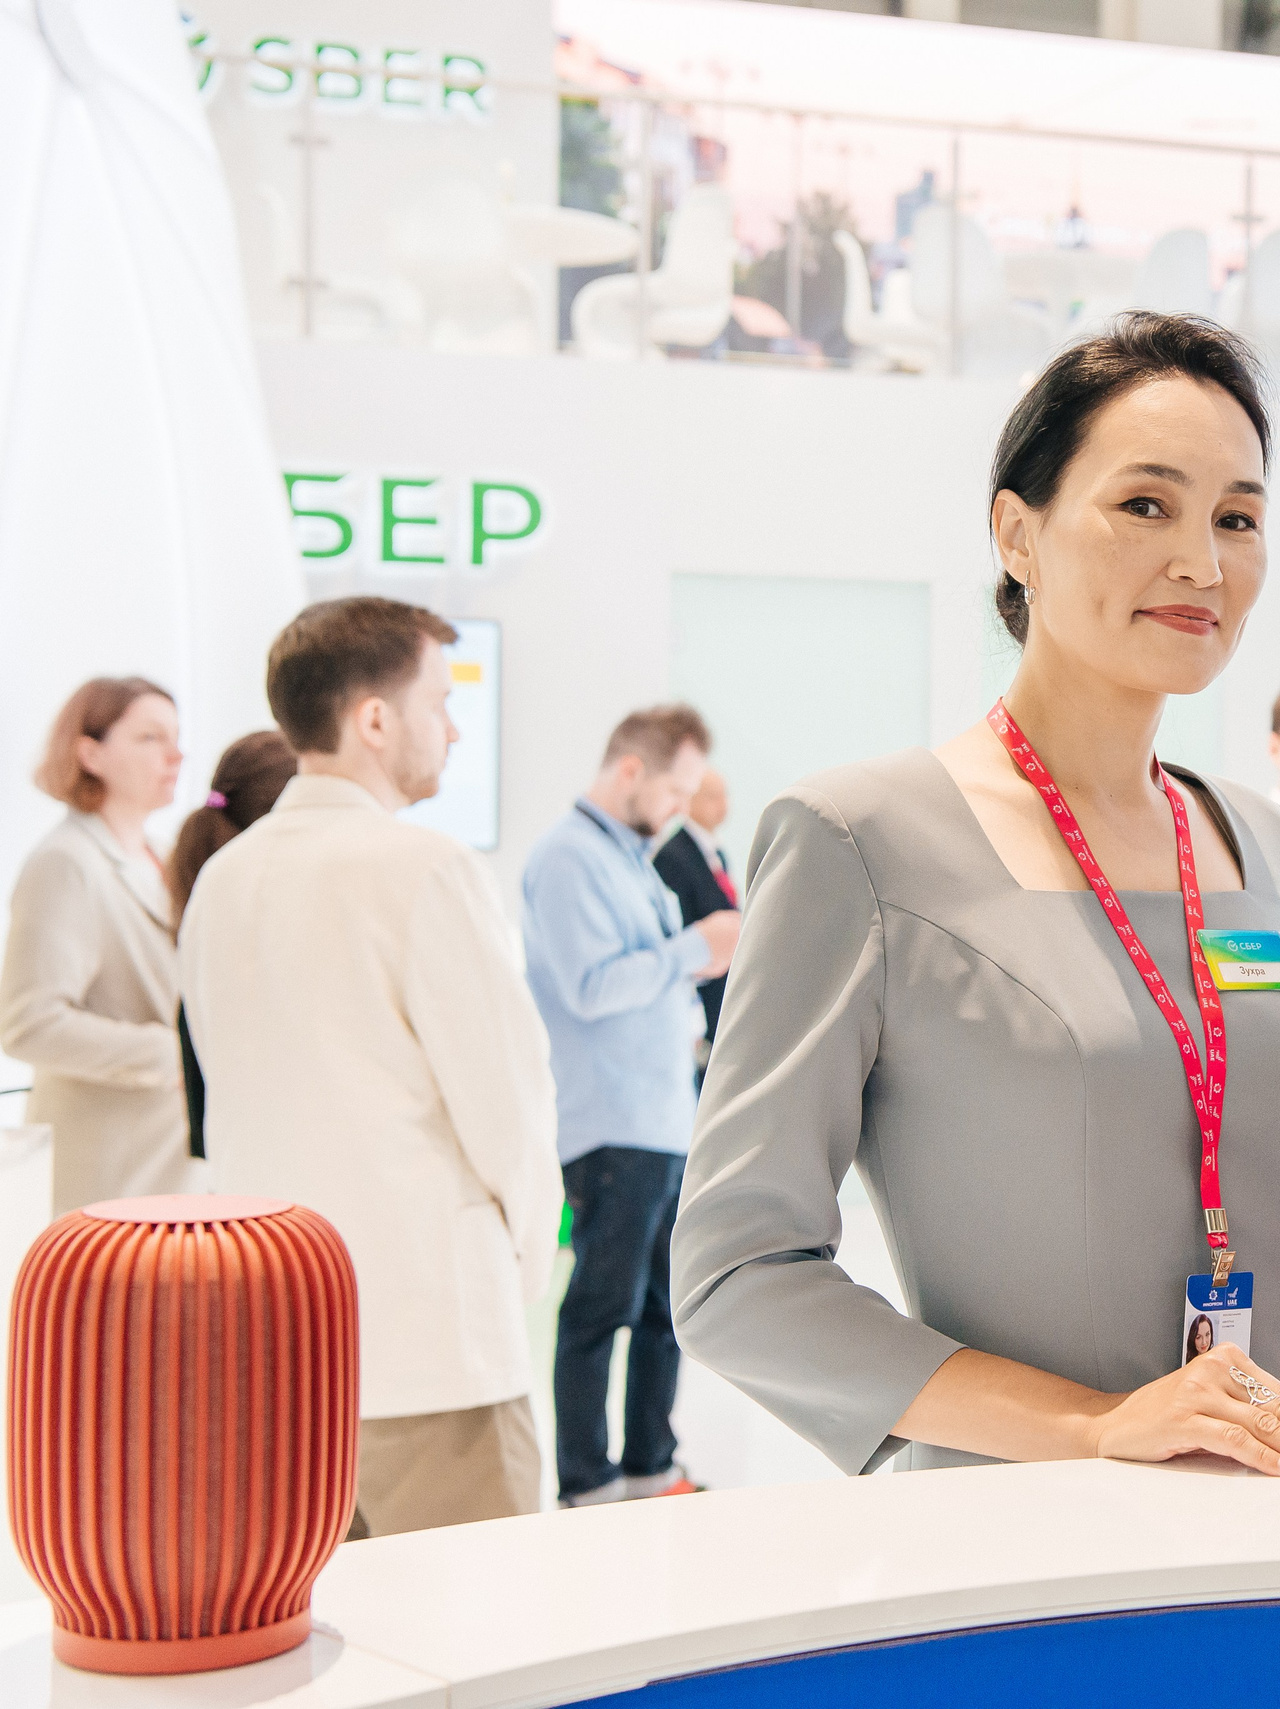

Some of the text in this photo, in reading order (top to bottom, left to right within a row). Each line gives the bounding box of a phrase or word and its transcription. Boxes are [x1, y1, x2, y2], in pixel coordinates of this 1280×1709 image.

[250, 36, 487, 112] SBER
[282, 471, 542, 564] БЕР
[1239, 941, 1262, 950] СБЕР
[1239, 965, 1266, 977] Зухра
[1227, 1298, 1238, 1306] UAE
